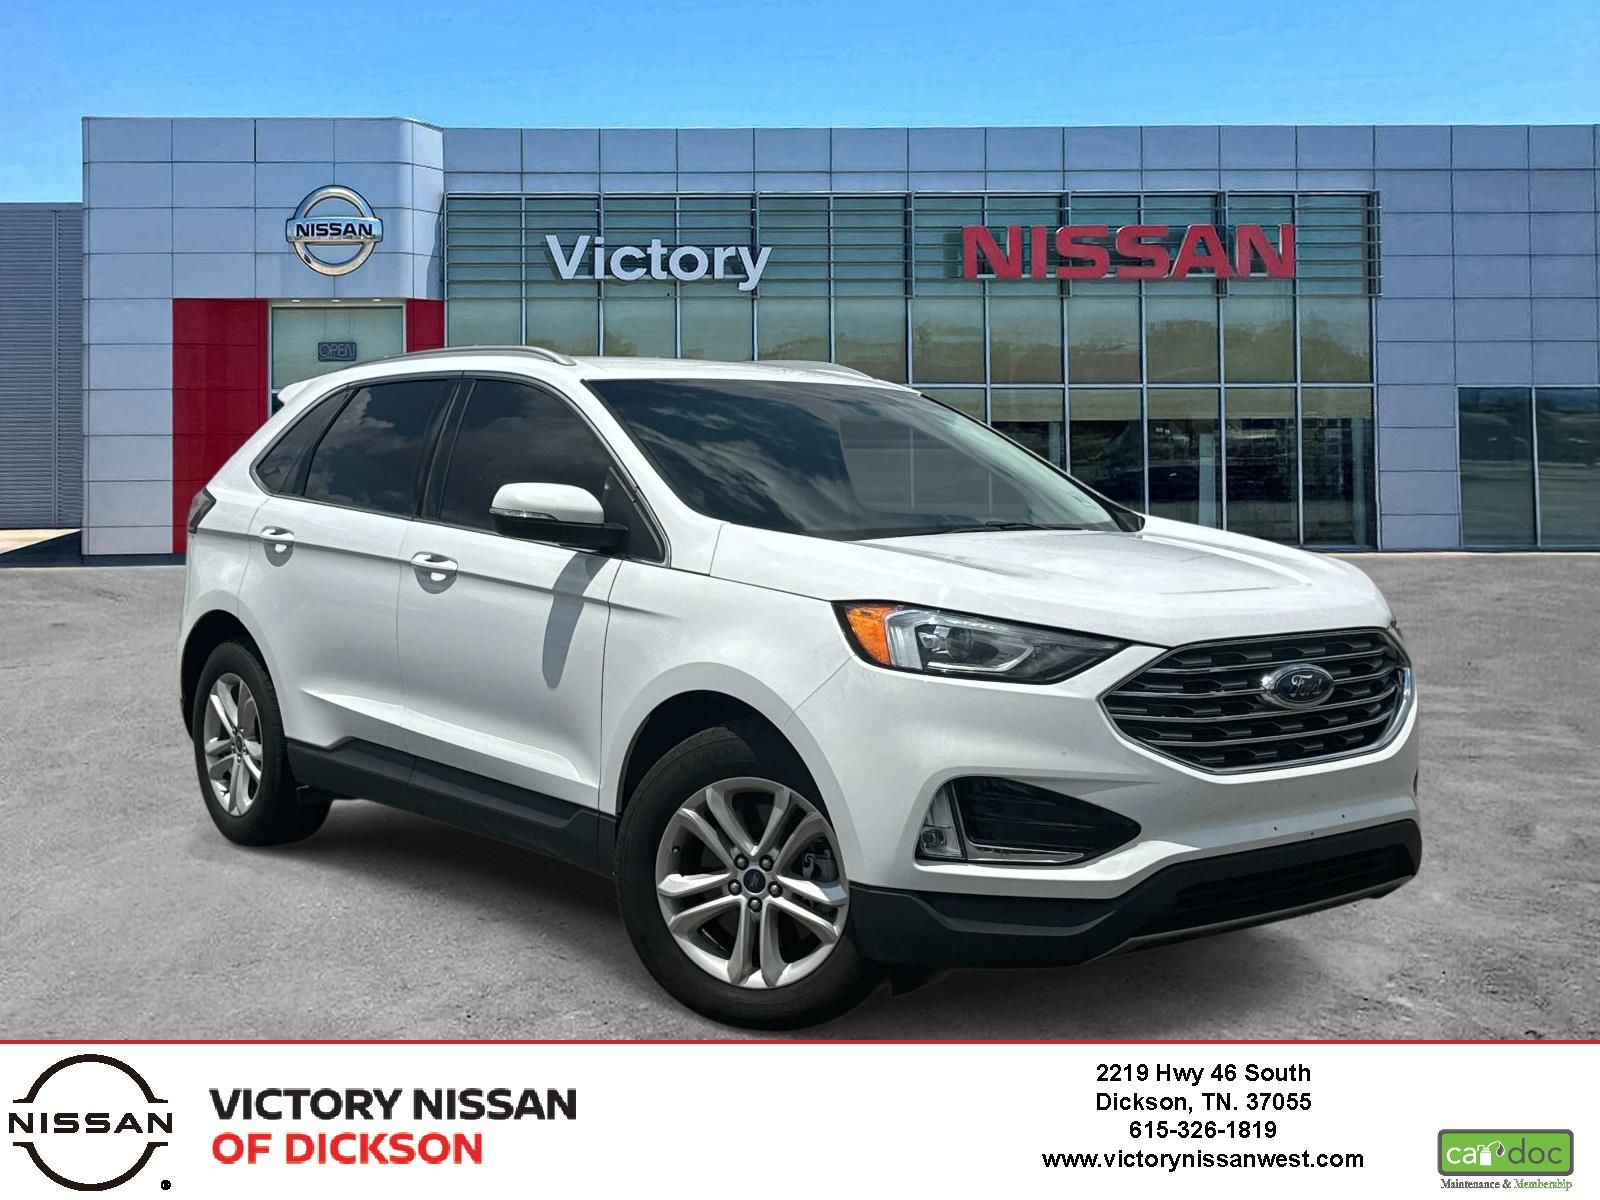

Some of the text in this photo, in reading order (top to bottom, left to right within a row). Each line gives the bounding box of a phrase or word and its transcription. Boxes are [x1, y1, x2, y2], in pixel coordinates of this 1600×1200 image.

[296, 223, 373, 237] NISSAN
[545, 234, 772, 291] Victory
[962, 224, 1295, 279] NISSAN
[320, 343, 355, 357] OPEN
